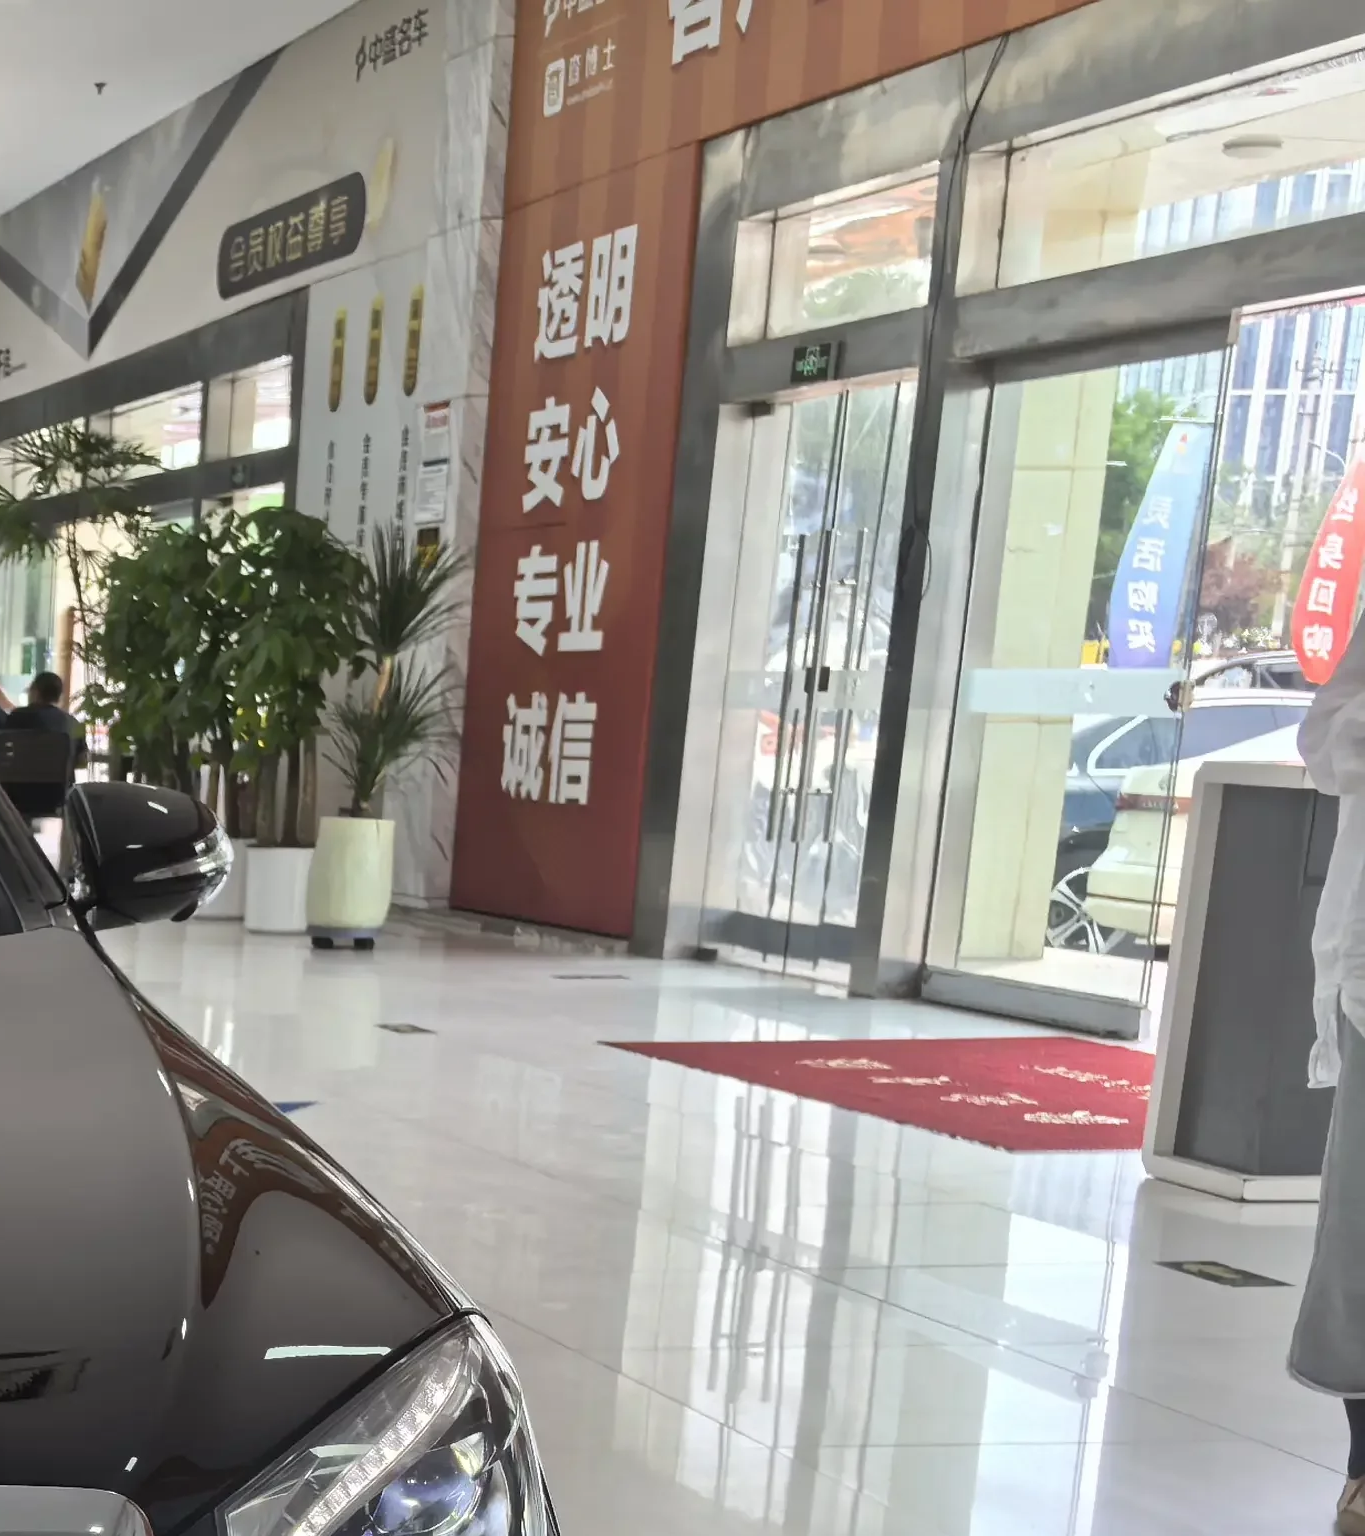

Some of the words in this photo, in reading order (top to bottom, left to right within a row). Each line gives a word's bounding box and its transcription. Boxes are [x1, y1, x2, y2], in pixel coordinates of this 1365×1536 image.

[368, 8, 429, 73] 中盛名车
[228, 194, 350, 283] 会员权益尊享
[534, 224, 638, 362] 透明
[522, 386, 621, 513] 安心
[513, 540, 609, 656] 专业
[500, 692, 598, 806] 诚信
